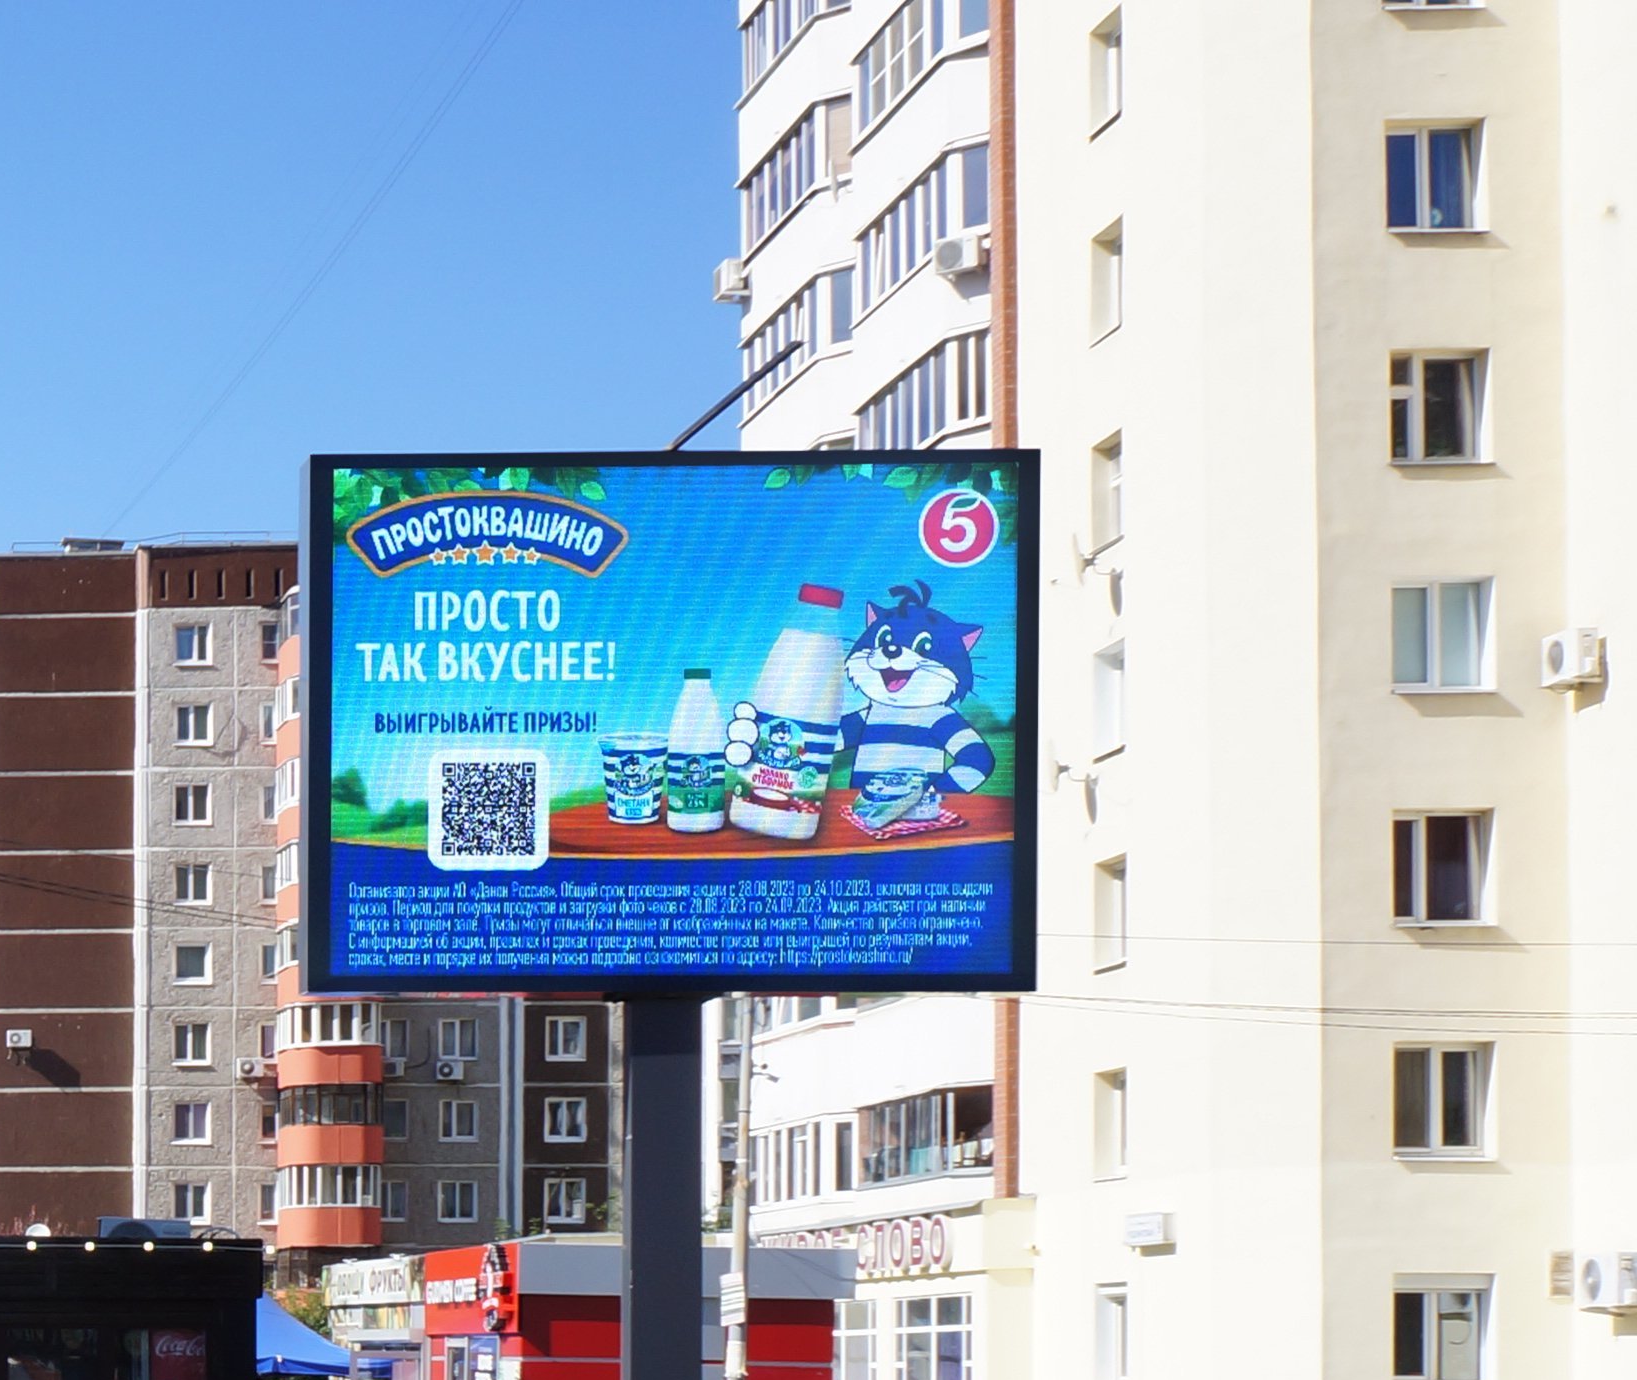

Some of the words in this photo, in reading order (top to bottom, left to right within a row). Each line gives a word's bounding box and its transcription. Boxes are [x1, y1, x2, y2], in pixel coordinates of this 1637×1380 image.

[371, 505, 604, 560] ПРОСТОКВАШИНО
[939, 494, 981, 553] 5
[413, 589, 562, 632] ПРОСТО
[355, 641, 428, 682] ТАК
[437, 640, 617, 682] ВКУСНЕЕ!
[374, 706, 519, 734] ВЫИГРЫВАЙТЕ
[523, 711, 598, 733] ПРИЗЫ!
[600, 884, 625, 900] срок
[925, 883, 950, 899] срок
[619, 898, 645, 918] фото
[856, 1215, 950, 1272] СЛОВО
[369, 1267, 406, 1296] ФРУКТЫ
